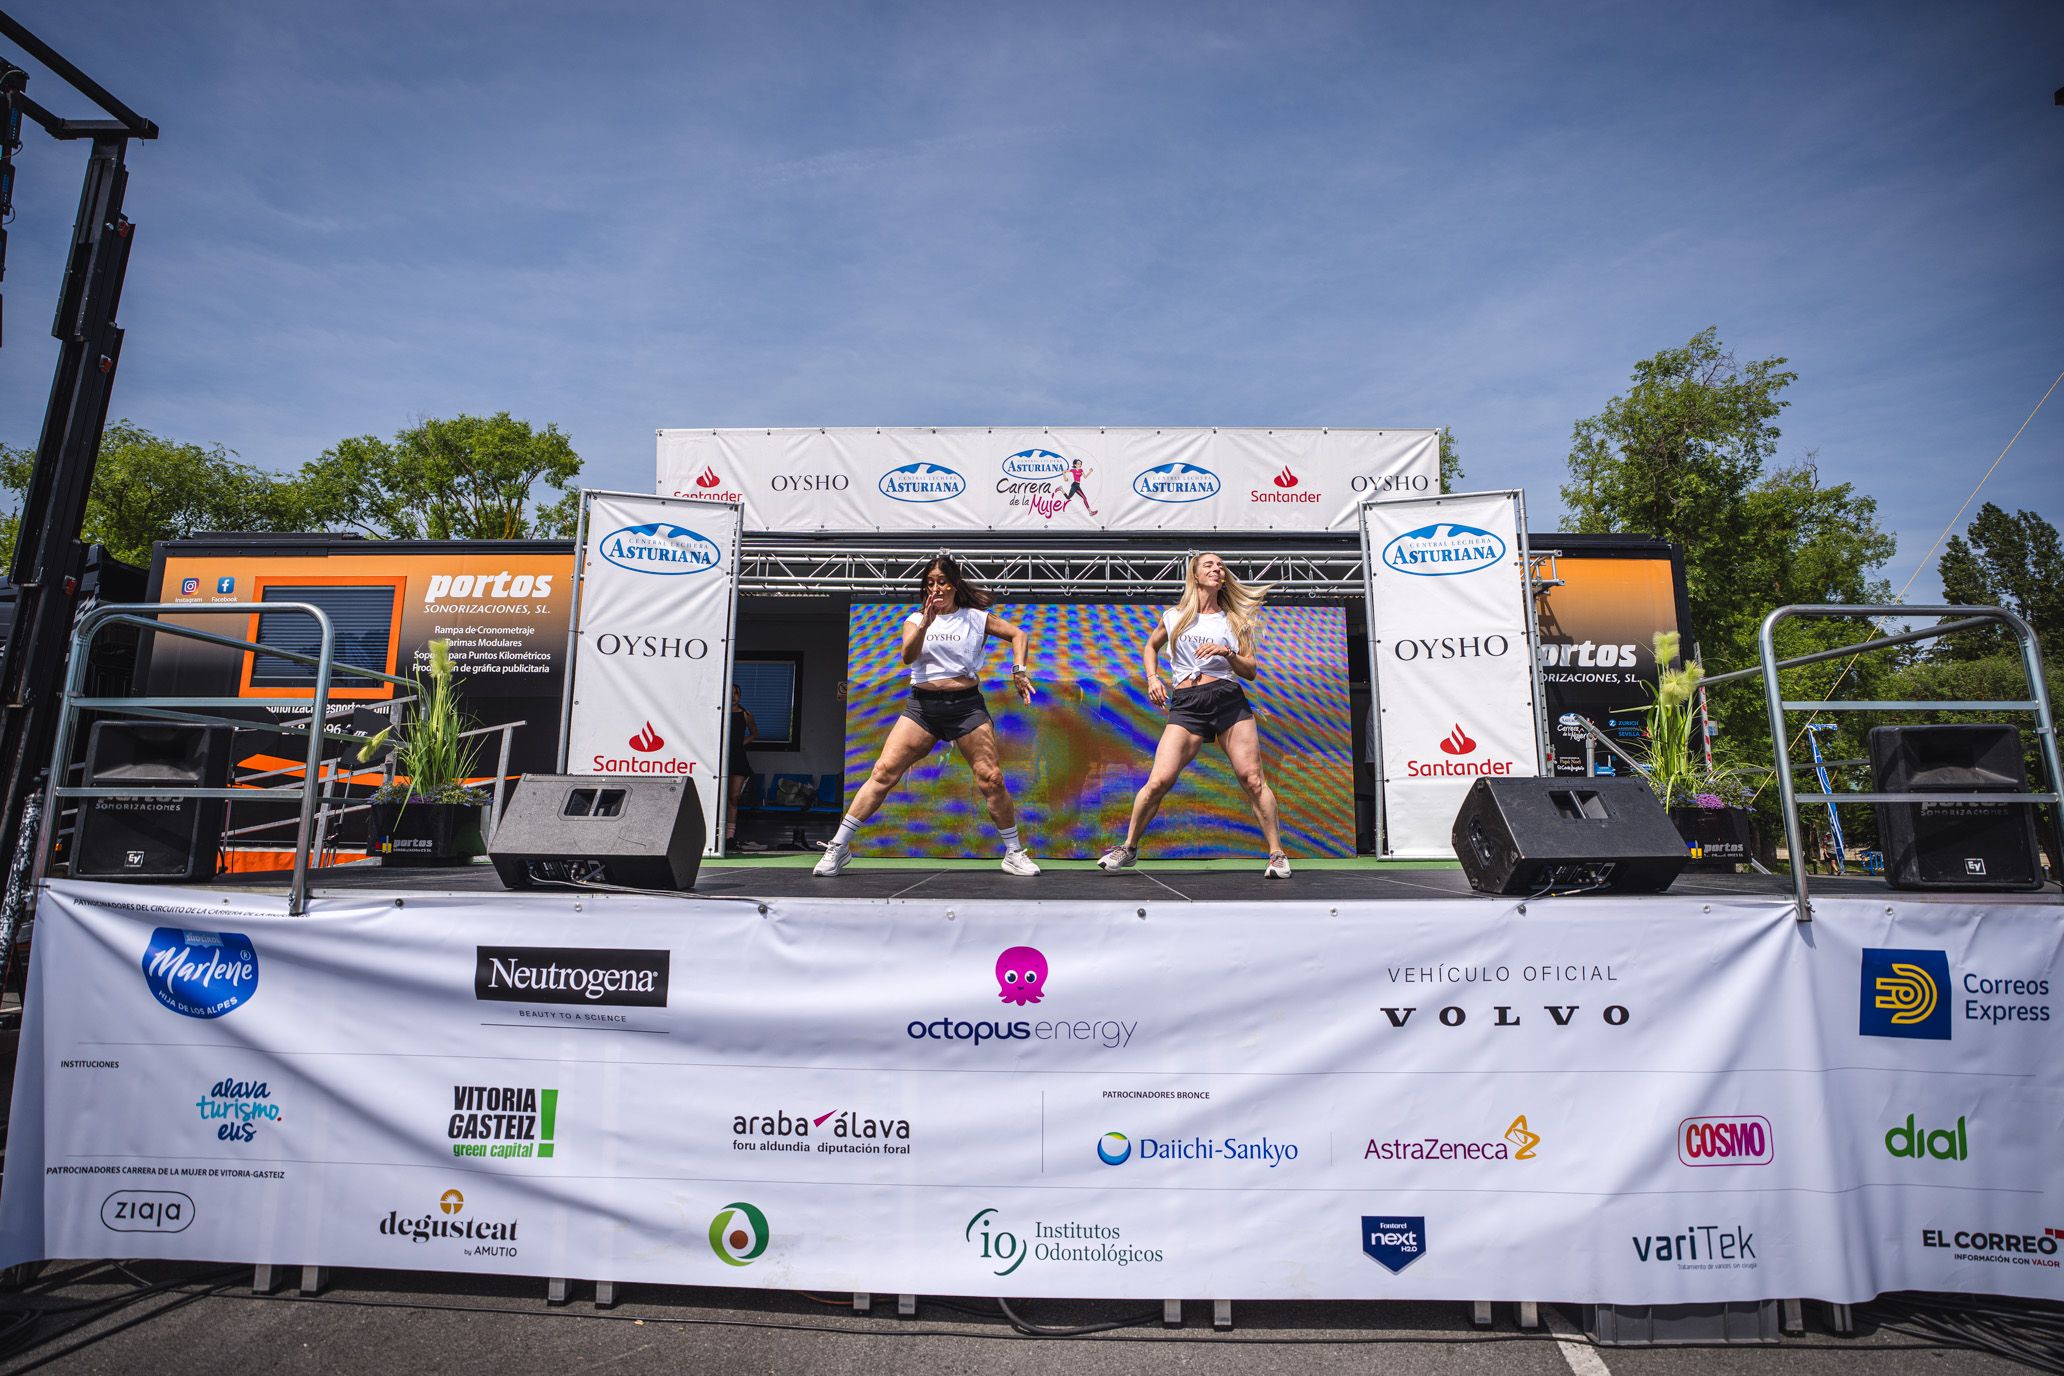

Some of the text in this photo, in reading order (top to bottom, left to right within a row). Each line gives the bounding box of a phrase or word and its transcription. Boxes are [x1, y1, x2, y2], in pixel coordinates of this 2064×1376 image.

[771, 475, 849, 491] OYSHO
[996, 478, 1052, 493] Carrera
[1351, 475, 1429, 492] OYSHO
[1009, 496, 1020, 506] de
[1028, 492, 1072, 519] Mujer
[1251, 490, 1321, 503] Santander
[424, 571, 552, 603] portos
[424, 604, 551, 615] SONORIZACIONES, SL.
[434, 625, 535, 636] Rampa de Cronometraje
[445, 638, 522, 647] Tarimas Modulares
[597, 633, 708, 659] OYSHO
[1395, 635, 1508, 661] OYSHO
[448, 652, 467, 661] para
[468, 652, 498, 660] Puntos
[499, 651, 551, 660] Kilométricos
[1540, 640, 1637, 667] ortos
[460, 663, 471, 672] de
[473, 663, 501, 674] gráfica
[502, 663, 550, 674] publicitaria
[1624, 674, 1640, 683] SL.
[593, 755, 697, 775] Santander
[1408, 759, 1513, 777] Santander
[96, 803, 181, 811] SONORIZACIONES
[394, 839, 432, 848] portos
[1704, 843, 1744, 853] portos
[150, 905, 184, 913] CIRCUITO
[149, 947, 252, 994] Marlene
[488, 958, 654, 999] Neutrogena
[1388, 964, 1617, 983] VEHÍCULO OFICIAL
[1964, 974, 2049, 995] Correos
[159, 990, 176, 1007] HIJA
[178, 1003, 189, 1012] DE
[207, 996, 238, 1015] ALPES
[519, 1010, 556, 1019] BEAUTY
[584, 1014, 627, 1023] SCIENCE
[1380, 1005, 1630, 1028] VOLVO
[1966, 1000, 2050, 1025] Express
[907, 1018, 1138, 1048] octopus energy
[61, 1060, 119, 1069] INSTITUCIONES
[211, 1078, 271, 1099] alava
[1102, 1091, 1175, 1099] PATROCINADORES
[454, 1086, 536, 1113] VITORIA
[217, 1122, 256, 1142] eus
[448, 1114, 536, 1140] GASTEIZ
[733, 1110, 910, 1139] araba álava
[1686, 1123, 1765, 1158] COSMO
[1885, 1113, 1968, 1161] dial
[453, 1143, 534, 1159] green capital
[733, 1140, 910, 1154] foru aldundia diputación foral
[1140, 1137, 1298, 1168] Daiichi-Sankyo
[1364, 1139, 1508, 1160] AstraZeneca
[46, 1166, 121, 1175] PATROCINADORES
[220, 1170, 285, 1179] VITORIA-GASTEIZ
[379, 1211, 519, 1243] degusteat
[1035, 1221, 1120, 1240] Institutos
[1371, 1231, 1417, 1245] next
[1632, 1225, 1756, 1262] variTek
[1922, 1229, 2058, 1255] EL CORREO
[474, 1246, 517, 1257] AMUTIO
[1034, 1243, 1163, 1266] Odontológicos
[1954, 1254, 2060, 1268] INFORMACIÓN CON VALOR
